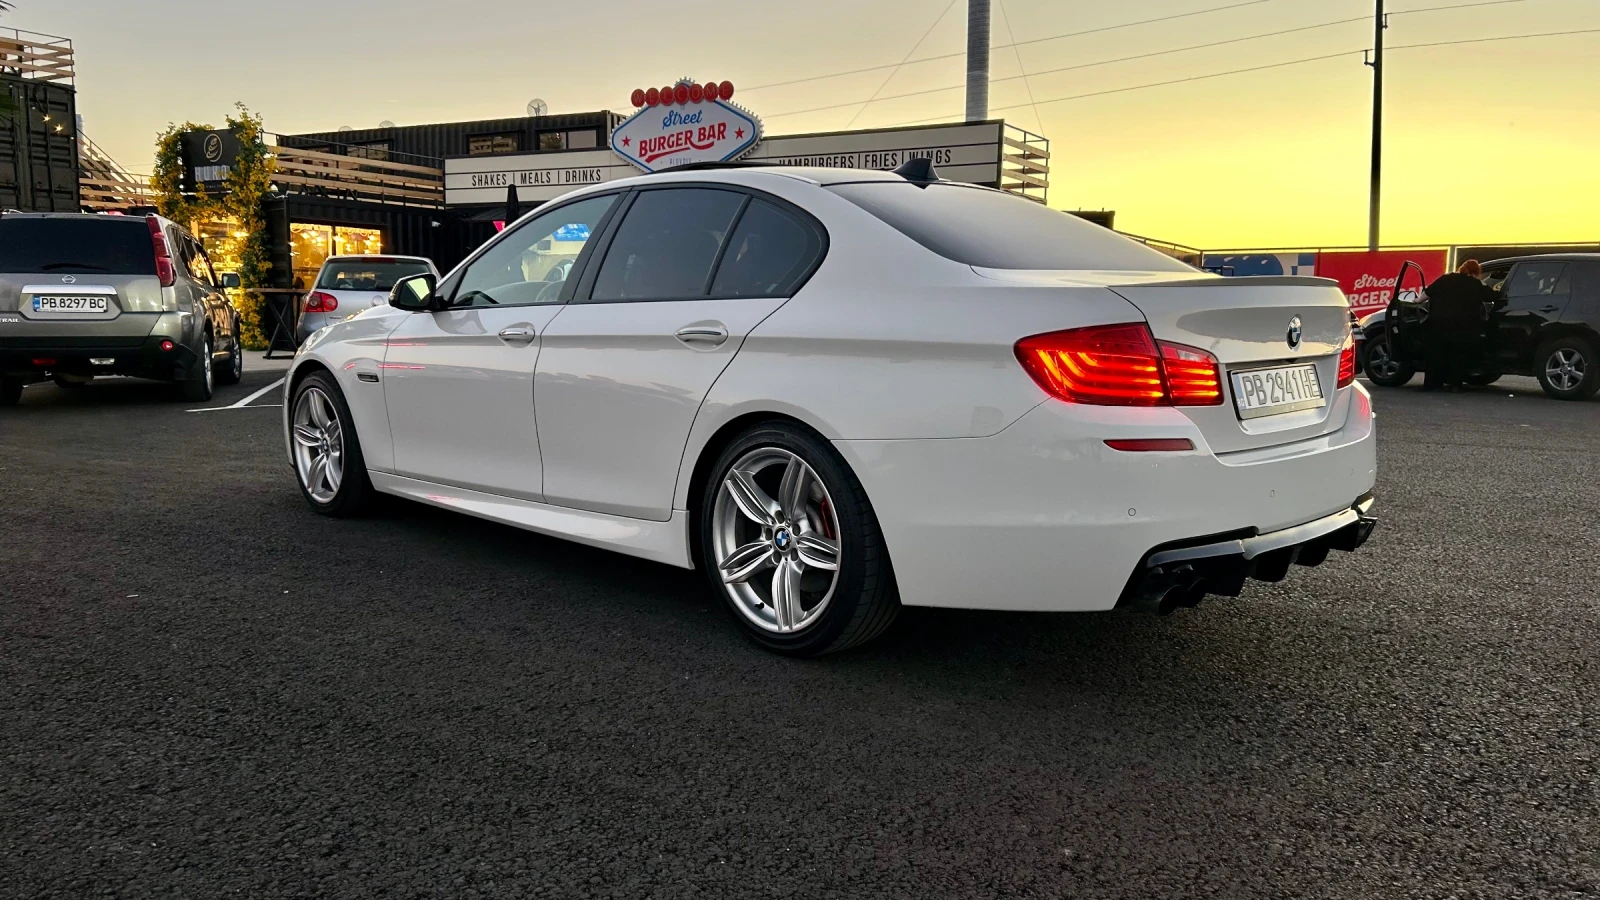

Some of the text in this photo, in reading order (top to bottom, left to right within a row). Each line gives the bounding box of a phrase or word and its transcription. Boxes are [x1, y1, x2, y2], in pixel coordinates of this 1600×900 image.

[632, 83, 731, 105] WELCOME
[662, 109, 703, 130] Street
[638, 122, 727, 158] BURGER BAR
[864, 153, 897, 168] FRIES
[471, 168, 601, 187] SHAKES MEALS DRINKS
[89, 298, 105, 309] BC
